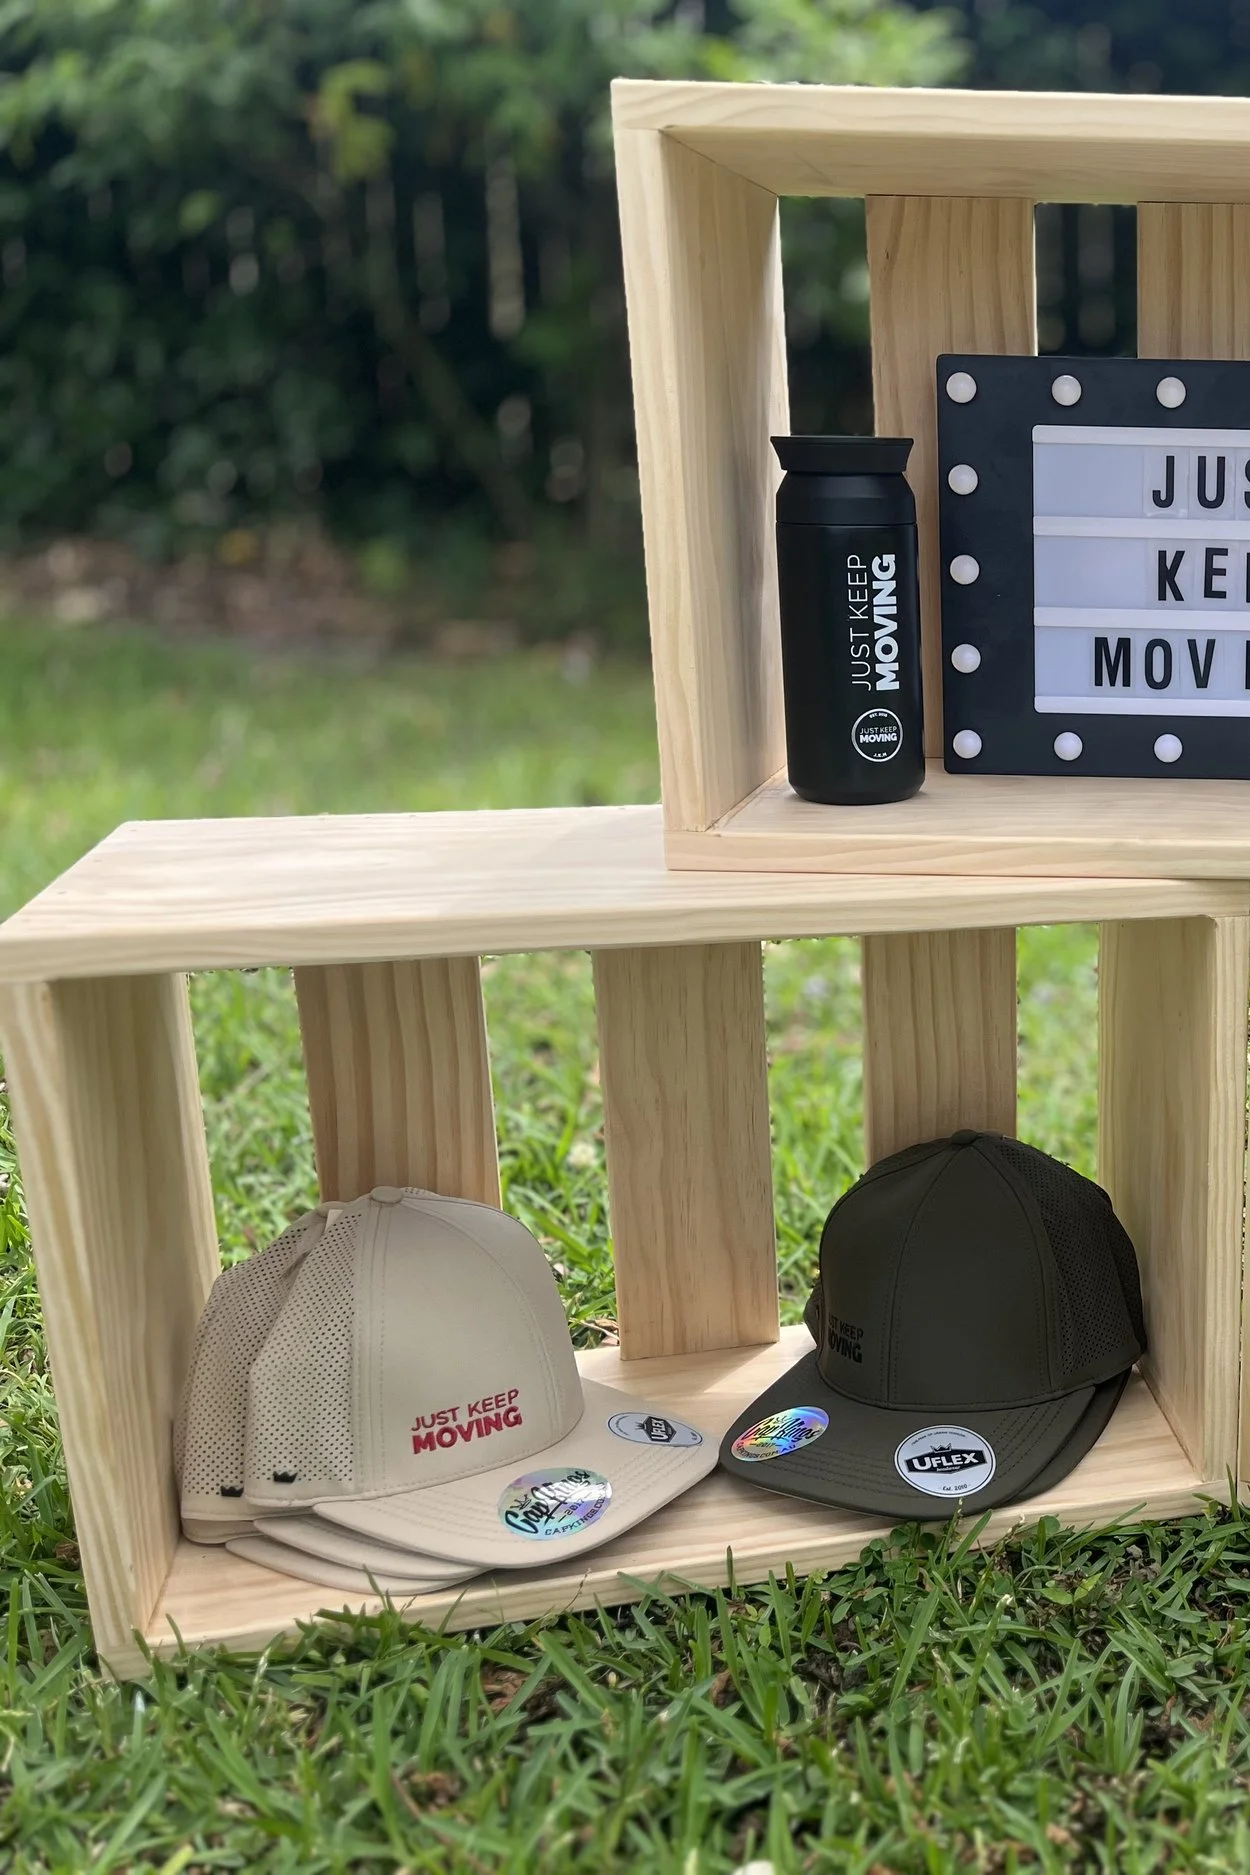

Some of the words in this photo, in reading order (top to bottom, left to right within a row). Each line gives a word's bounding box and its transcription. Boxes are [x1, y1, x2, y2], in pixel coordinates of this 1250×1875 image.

[847, 554, 869, 619] KEEP
[871, 554, 900, 691] MOVING
[850, 627, 871, 691] JUST
[859, 732, 898, 744] MOVING
[880, 725, 897, 733] KEEP
[828, 1328, 863, 1364] OVING
[840, 1320, 864, 1341] KEEP
[411, 1406, 460, 1431] JUST
[467, 1388, 519, 1417] KEEP
[412, 1405, 523, 1454] MOVING
[912, 1452, 979, 1471] UFLEX
